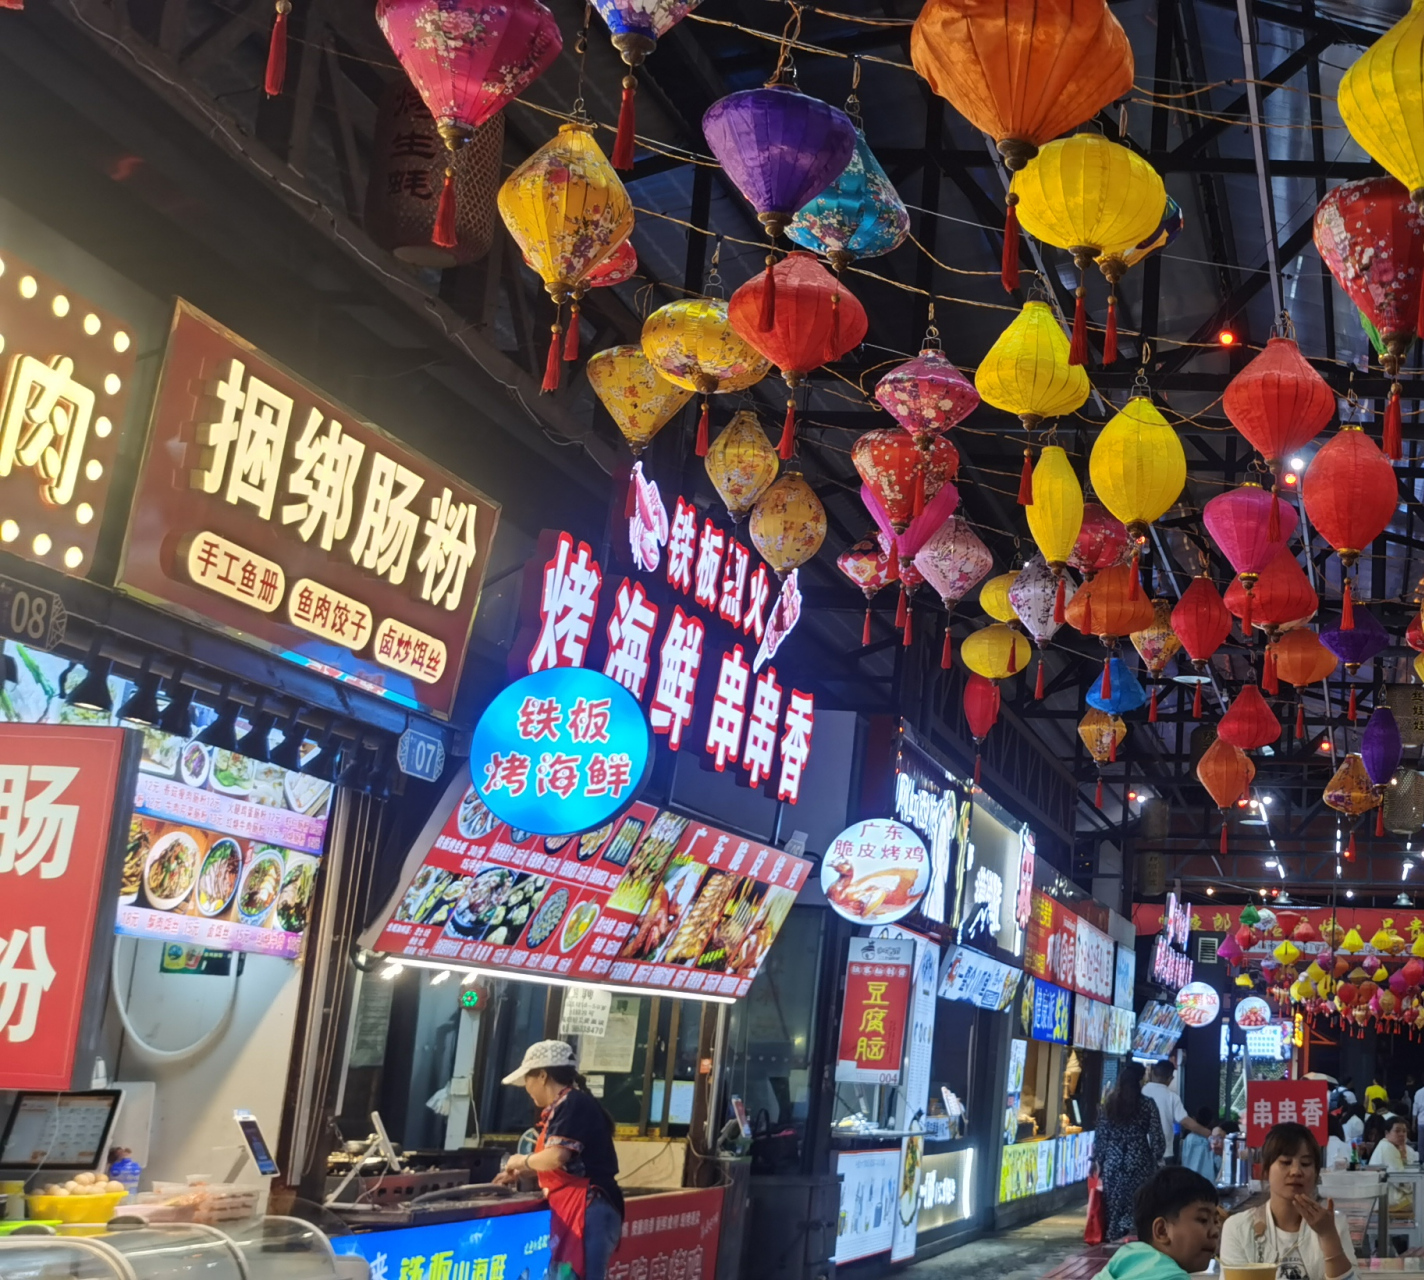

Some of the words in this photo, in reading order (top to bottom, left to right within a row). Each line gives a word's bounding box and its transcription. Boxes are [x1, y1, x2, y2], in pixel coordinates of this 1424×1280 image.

[0, 354, 95, 505] 肉
[203, 358, 477, 611] 捆绑肠粉
[197, 541, 280, 606] 手工鱼册
[668, 496, 770, 645] 铁板烈火
[11, 591, 47, 639] 08
[298, 587, 368, 643] 鱼肉饺子
[378, 629, 442, 679] 卤炒饵丝
[518, 696, 612, 743] 铁板
[414, 744, 437, 772] 07
[482, 752, 632, 799] 烤海鲜
[833, 839, 924, 863] 脆皮烤鸡
[860, 822, 904, 840] 广东
[854, 981, 890, 1062] 豆腐脑
[879, 1073, 898, 1083] 004
[1253, 1098, 1323, 1128] 串串香
